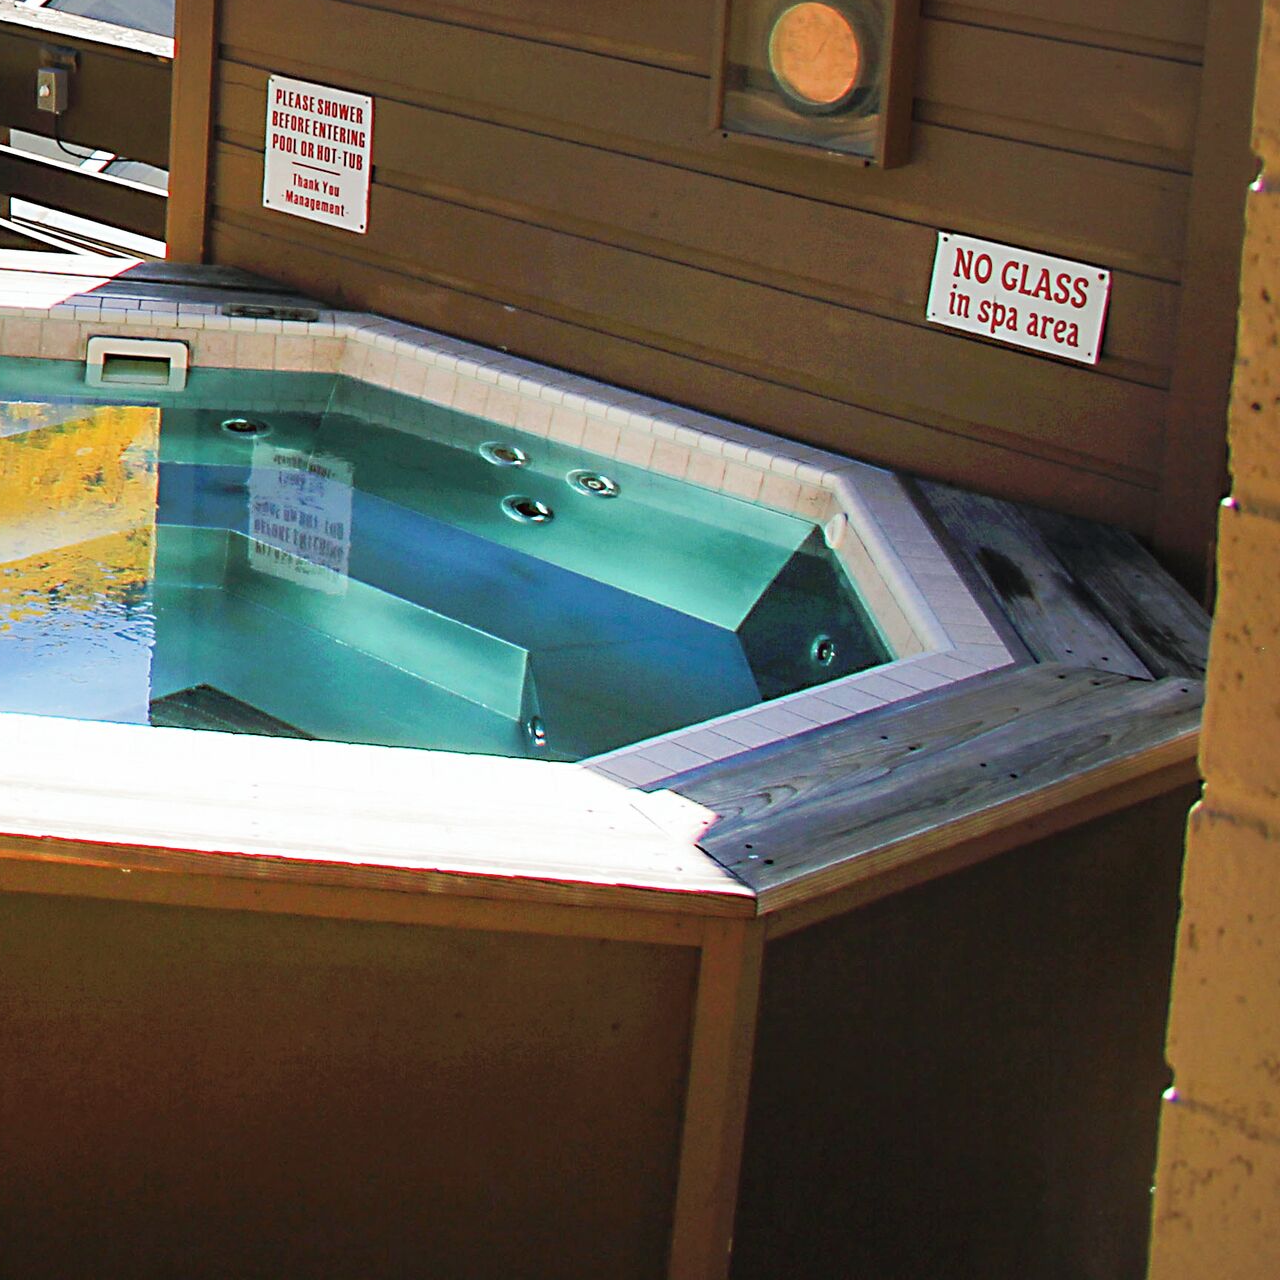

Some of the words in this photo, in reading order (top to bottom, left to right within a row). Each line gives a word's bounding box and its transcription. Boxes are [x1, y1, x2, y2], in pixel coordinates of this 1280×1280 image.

[276, 89, 315, 113] PLEASE
[317, 99, 363, 124] SHOWER
[272, 111, 310, 135] BEFORE
[313, 120, 366, 148] ENTERING
[272, 133, 298, 155] POOL
[301, 141, 314, 158] OR
[317, 144, 363, 171] HOT-TUB
[293, 173, 320, 192] Thank
[322, 180, 340, 197] You
[953, 247, 993, 284] NO
[1001, 260, 1089, 309] GLASS
[949, 283, 970, 318] in
[977, 299, 1018, 334] spa
[1026, 312, 1079, 348] area
